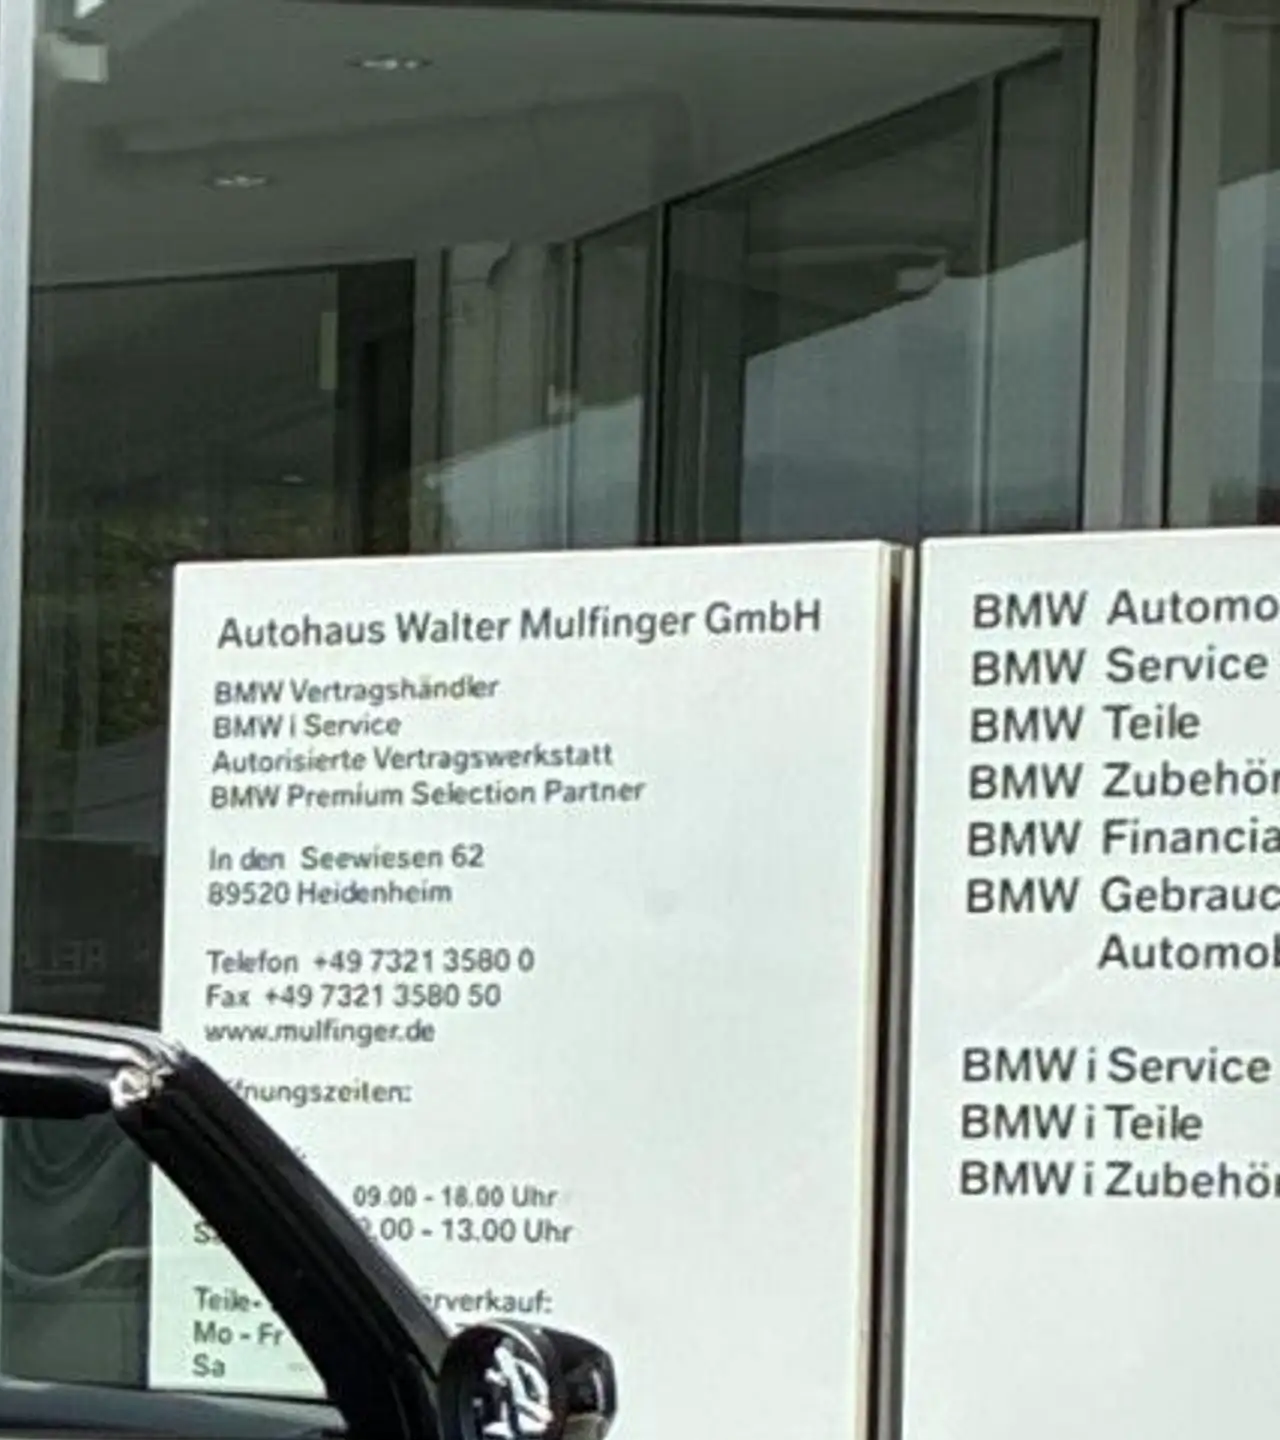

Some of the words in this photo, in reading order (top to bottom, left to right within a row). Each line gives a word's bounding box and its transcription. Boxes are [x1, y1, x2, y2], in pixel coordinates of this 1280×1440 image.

[217, 614, 386, 650] Autohaus
[395, 610, 511, 644] Walter
[520, 605, 697, 645] Mulfinger
[704, 598, 821, 636] GmbH
[973, 590, 1088, 630] BMW
[1106, 588, 1280, 626] Automo
[972, 648, 1087, 687] BMW
[1106, 644, 1269, 684] Service
[214, 680, 285, 706] BMW
[289, 674, 500, 708] Vertragshändler
[213, 714, 284, 740] BMW
[303, 712, 403, 739] Service
[970, 705, 1085, 744] BMW
[1102, 702, 1201, 741] Teile
[211, 748, 367, 774] Autorisierte
[373, 742, 613, 776] Vertragswerkstatt
[210, 784, 281, 810] BMW
[286, 781, 404, 809] Premium
[411, 780, 537, 807] Selection
[543, 778, 646, 804] Partner
[969, 762, 1084, 801] BMW
[967, 819, 1082, 858] BMW
[1102, 816, 1280, 855] Financia
[208, 847, 233, 872] In
[239, 846, 286, 872] den
[300, 845, 444, 871] Seewiesen
[450, 842, 485, 869] 62
[207, 880, 291, 907] 89520
[296, 879, 453, 906] Heidenheim
[966, 876, 1080, 914] BMW
[1100, 875, 1280, 914] Gebrauc
[205, 948, 299, 974] Telefon
[313, 948, 363, 974] +49
[370, 948, 433, 974] 7321
[443, 946, 511, 974] 3580
[517, 946, 536, 973] 0
[205, 983, 250, 1009] Fax
[265, 983, 314, 1009] +49
[320, 982, 383, 1009] 7321
[393, 982, 461, 1009] 3580
[467, 982, 502, 1008] 50
[204, 1017, 436, 1049] www.mulfinger.de
[962, 1046, 1077, 1083] BMW
[1087, 1046, 1097, 1083] i
[1107, 1046, 1272, 1084] Service
[961, 1103, 1076, 1140] BMW
[1085, 1103, 1095, 1140] i
[1103, 1103, 1203, 1142] Teile
[960, 1159, 1075, 1197] BMW
[1083, 1160, 1094, 1197] i
[511, 1185, 559, 1208] Uhr
[441, 1217, 517, 1244] 13.00
[523, 1218, 574, 1244] Uhr
[193, 1319, 233, 1346] Mo
[258, 1321, 285, 1346] Fr
[192, 1352, 226, 1379] Sa
